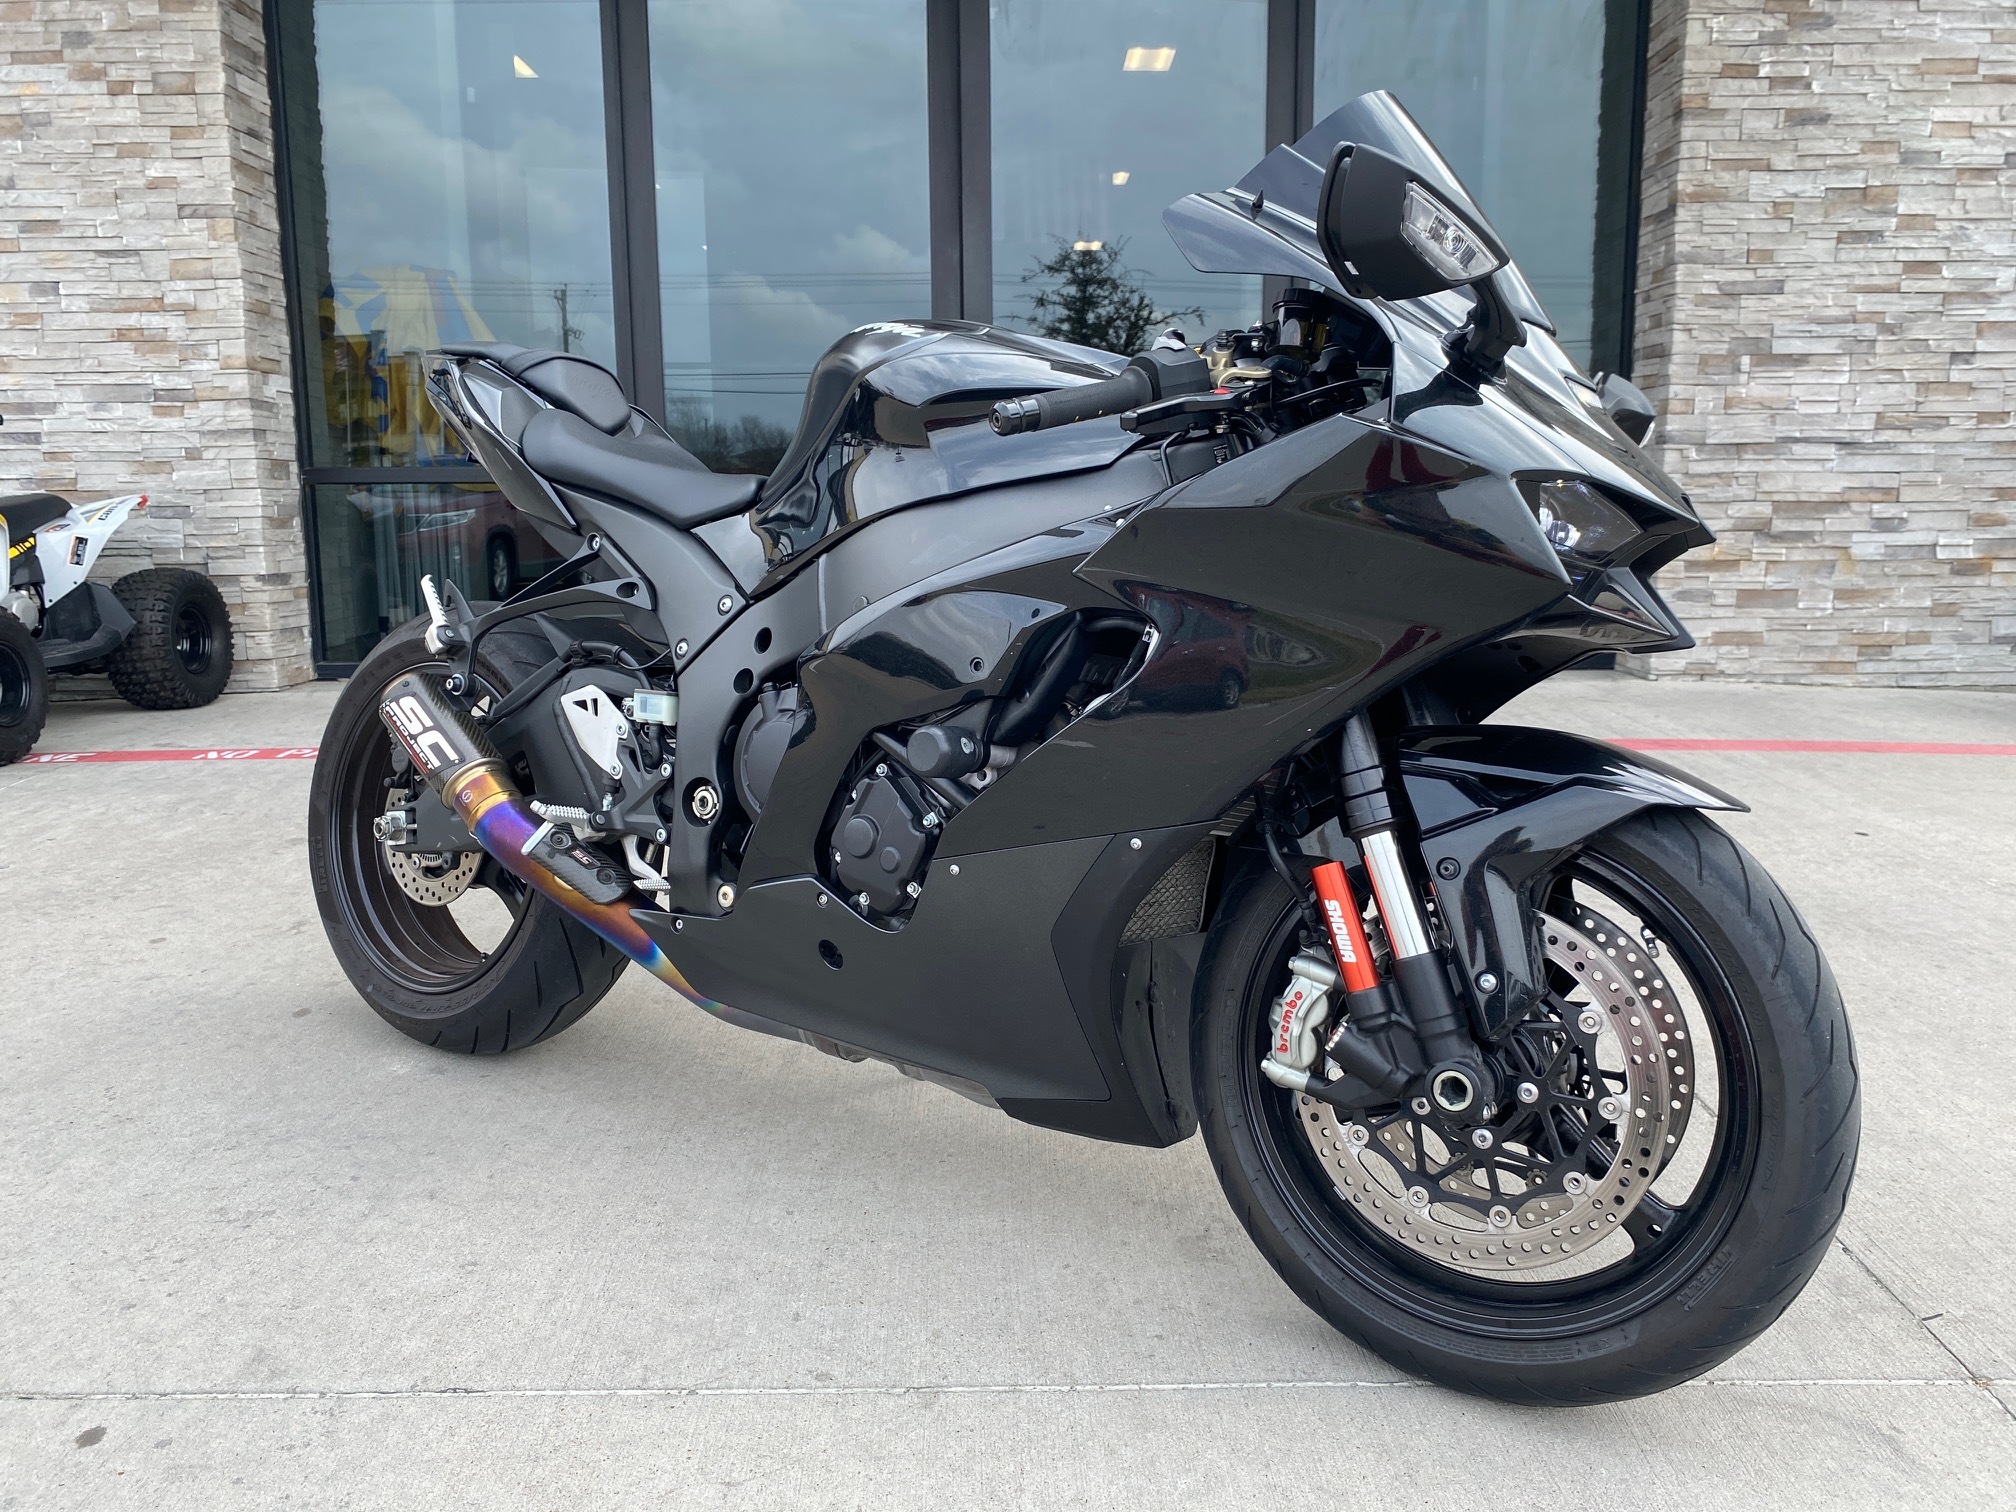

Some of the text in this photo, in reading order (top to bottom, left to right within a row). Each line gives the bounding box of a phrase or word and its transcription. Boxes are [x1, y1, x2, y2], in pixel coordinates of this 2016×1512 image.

[390, 695, 460, 768] SC
[1324, 899, 1356, 963] SHOWA
[1277, 990, 1303, 1054] brembo
